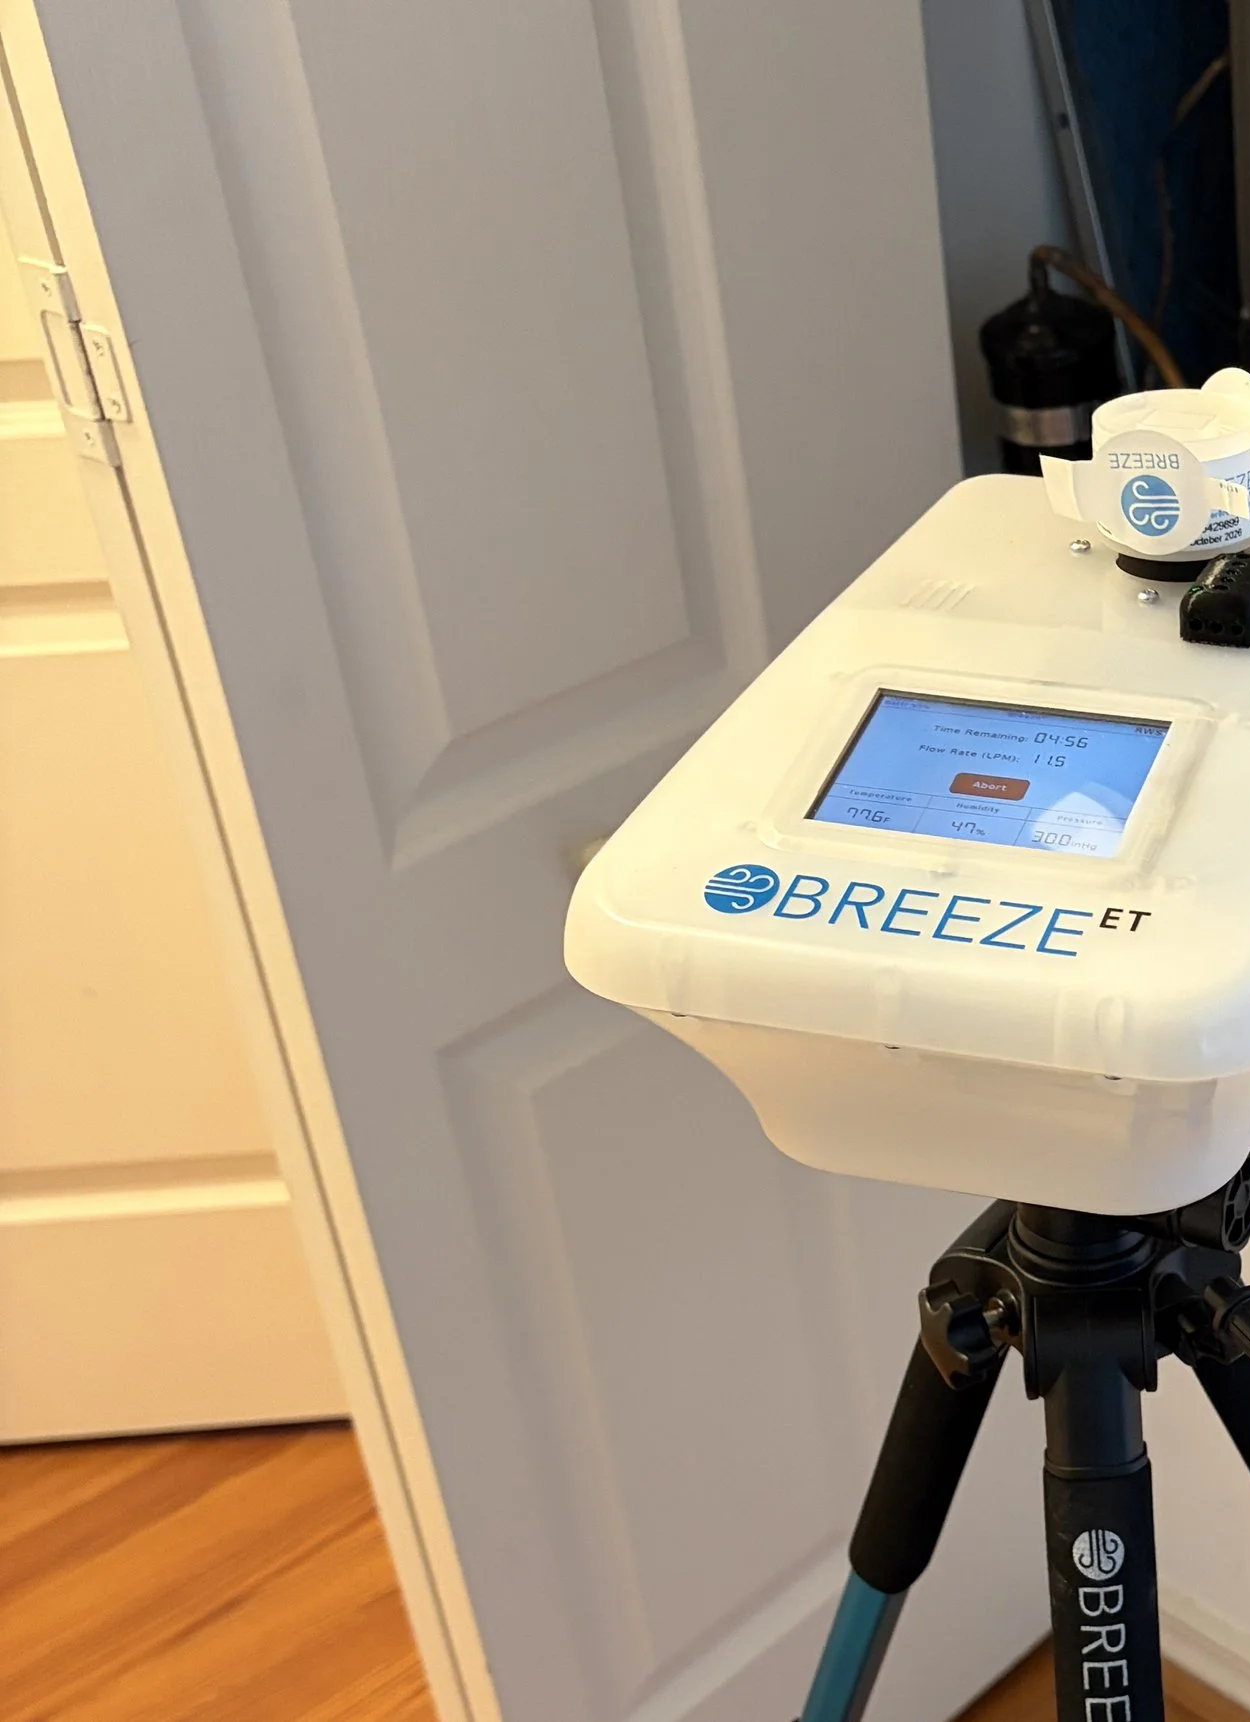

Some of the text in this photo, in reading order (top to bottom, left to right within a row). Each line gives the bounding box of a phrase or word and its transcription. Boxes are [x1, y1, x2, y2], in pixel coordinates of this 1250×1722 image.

[1108, 453, 1180, 470] BREEZE
[933, 724, 1088, 749] Time Remaining: 04:56
[919, 744, 946, 754] Flow
[950, 748, 977, 758] Rate
[981, 752, 1020, 763] (LPM):
[972, 780, 1007, 792] Abort
[849, 789, 912, 802] Temperature
[956, 803, 1000, 814] Humidity
[1057, 815, 1103, 825] Pressure
[773, 874, 1151, 957] BREEZE ET
[1078, 1584, 1131, 1722] BREE
